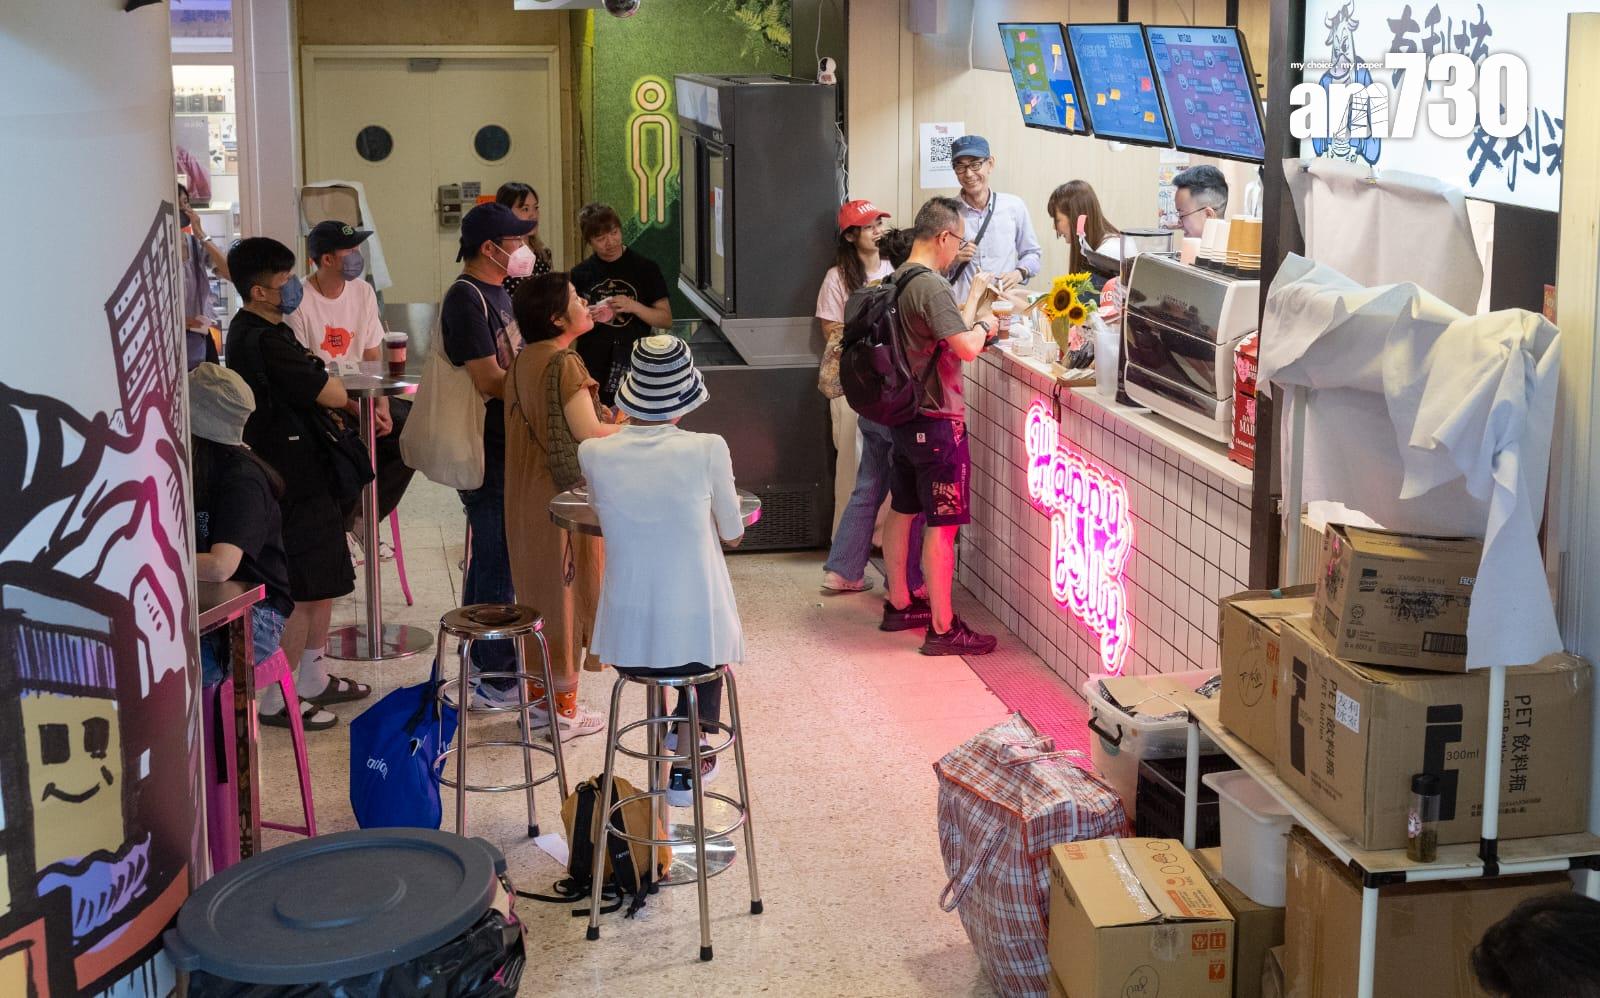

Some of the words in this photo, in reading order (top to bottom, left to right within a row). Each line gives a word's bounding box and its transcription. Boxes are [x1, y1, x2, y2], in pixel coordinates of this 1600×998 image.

[1515, 694, 1532, 728] PET
[1446, 748, 1480, 761] 300ml
[1508, 734, 1531, 793] 飲料瓶
